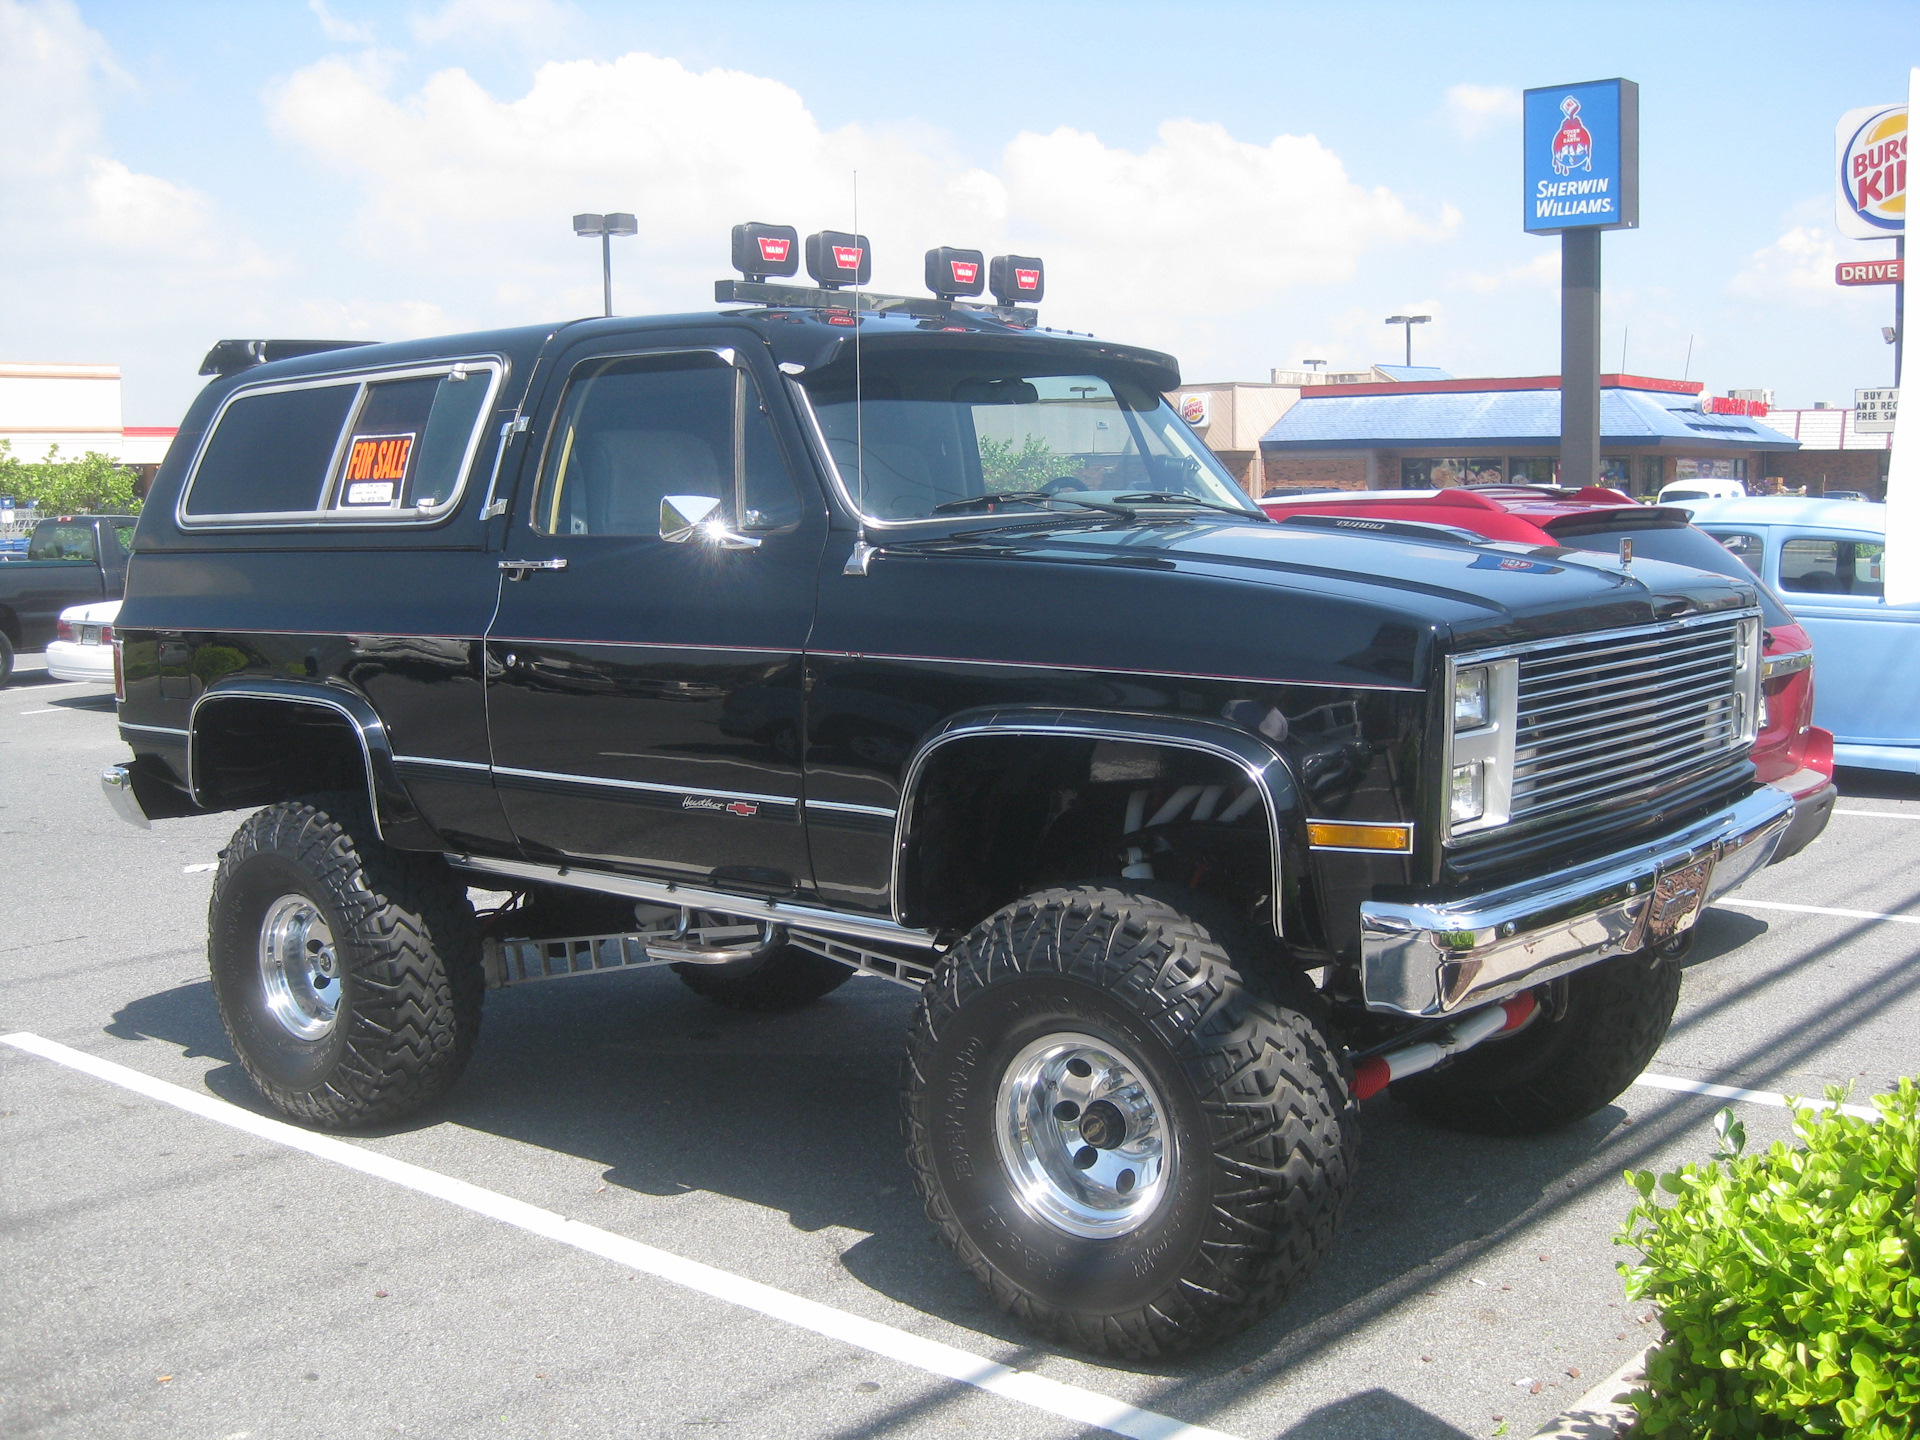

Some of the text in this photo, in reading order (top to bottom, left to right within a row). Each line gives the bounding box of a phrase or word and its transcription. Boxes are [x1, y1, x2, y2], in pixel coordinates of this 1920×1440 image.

[1536, 178, 1609, 198] SHERWIN
[1536, 198, 1611, 218] WILLIAMS
[765, 245, 784, 254] WARN
[840, 254, 857, 262] WARN
[957, 268, 973, 277] WARN
[1841, 264, 1898, 281] DRIVE
[1021, 275, 1035, 283] WARN
[1863, 391, 1894, 400] BUY A
[1712, 396, 1746, 415] BURGER
[1747, 400, 1768, 417] KING
[1856, 402, 1876, 410] AND
[1184, 406, 1203, 419] KING
[1856, 412, 1878, 420] FREE
[347, 439, 411, 480] FOR SALE
[1336, 520, 1385, 530] TURBO
